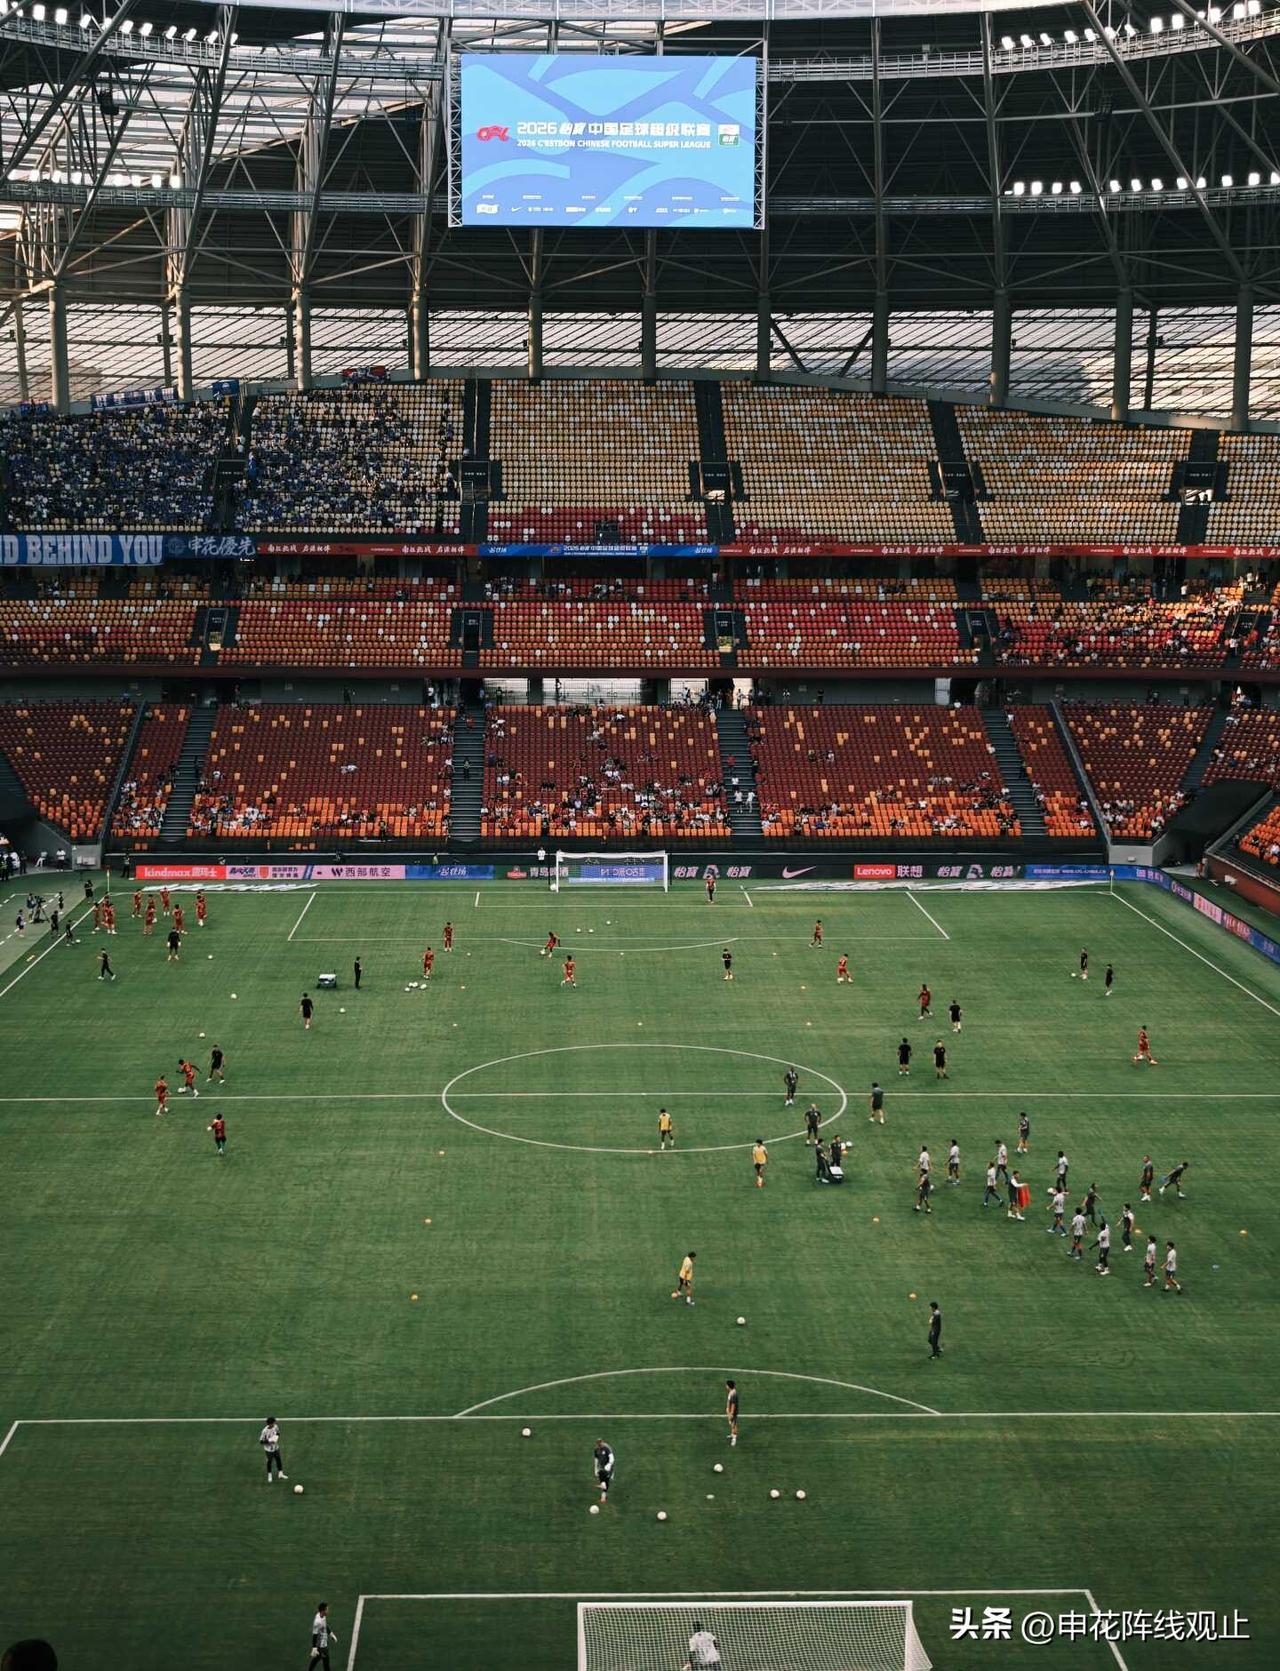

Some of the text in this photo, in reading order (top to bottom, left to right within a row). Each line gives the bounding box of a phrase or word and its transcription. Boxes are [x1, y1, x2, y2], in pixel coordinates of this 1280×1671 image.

[517, 121, 557, 135] 2026
[577, 140, 610, 148] CHINESE
[612, 141, 652, 149] FOOTBALL
[653, 141, 679, 149] SUPER
[681, 141, 711, 149] LEAGUE
[0, 534, 164, 564] D BEHIND YOU
[144, 867, 190, 877] kindmax
[345, 867, 391, 877] 西部航空
[857, 865, 923, 877] Lenovo 联想
